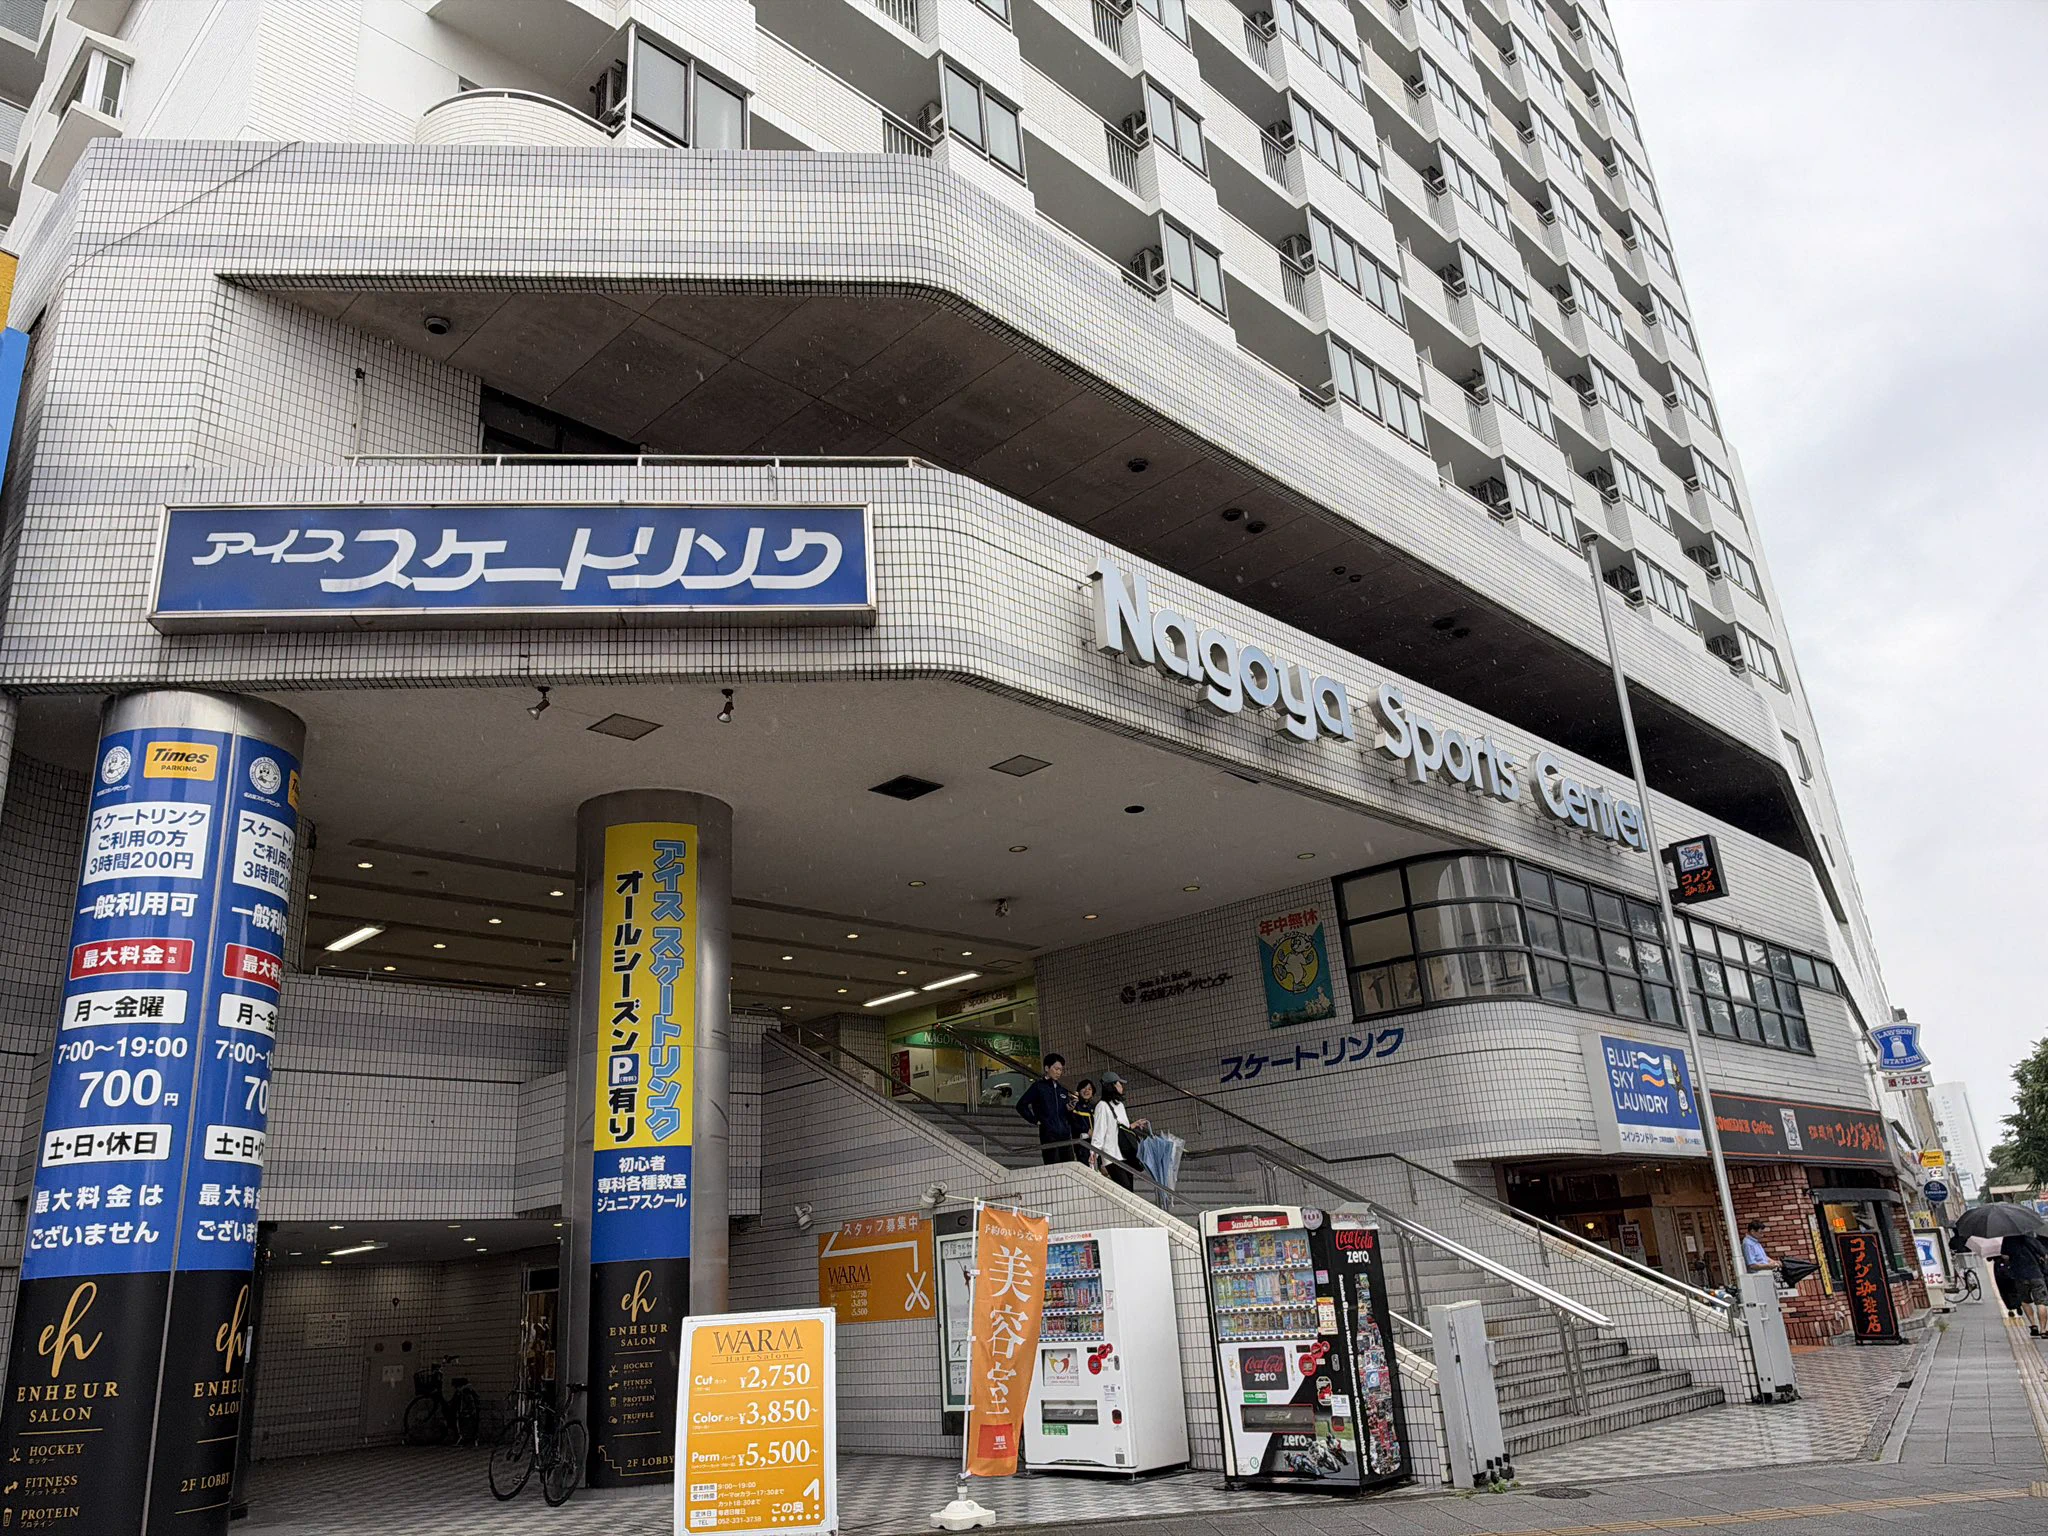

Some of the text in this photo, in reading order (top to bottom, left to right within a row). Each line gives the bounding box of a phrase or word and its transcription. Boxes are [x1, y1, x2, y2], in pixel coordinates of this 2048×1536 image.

[1086, 556, 1354, 743] Nagoya
[1368, 681, 1520, 803] Sports
[153, 748, 209, 764] Times
[161, 765, 198, 773] PARKING
[92, 808, 206, 833] スケートリンク
[98, 830, 189, 851] ご利用の方
[90, 851, 194, 875] 3時間200円
[79, 891, 198, 920] 一般利用可
[1259, 908, 1318, 936] 年中無休
[82, 945, 165, 969] 最大料金
[645, 839, 686, 1142] アイス スケートリンク
[1877, 1028, 1912, 1039] LAWSON
[1220, 1027, 1404, 1084] スケートリンク
[1606, 1047, 1639, 1069] BLUE
[1883, 1054, 1920, 1065] STATION
[1611, 1069, 1634, 1090] SKY
[1615, 1091, 1669, 1114] LAUNDRY
[1751, 1119, 1775, 1136] Coffee
[1621, 1131, 1658, 1144] コインランドリー
[618, 1155, 666, 1173] 初心者
[597, 1174, 687, 1193] 専科各種教室
[34, 1184, 164, 1214] 最大料金は
[597, 1192, 687, 1213] ジュニアスクール
[844, 1215, 918, 1236] スタッフ募集中
[1252, 1216, 1259, 1227] 8
[1259, 1218, 1277, 1227] hours
[31, 1221, 159, 1249] ございません
[984, 1224, 1043, 1241] 予約のいらない
[1346, 1250, 1370, 1264] zero
[828, 1263, 871, 1285] WARM
[610, 1323, 668, 1336] ENHEUR
[986, 1245, 1034, 1416] 美容室
[620, 1336, 656, 1347] SALON
[713, 1326, 803, 1354] WARM
[623, 1362, 654, 1370] HOCKEY
[623, 1378, 653, 1387] FITNESS
[694, 1374, 713, 1386] Cut
[740, 1362, 811, 1390] ¥2,750
[1254, 1372, 1277, 1382] zero
[17, 1380, 120, 1402] ENHEUR
[622, 1395, 656, 1403] PROTEIN
[29, 1406, 93, 1423] SALON
[623, 1411, 655, 1420] TRUFFLE
[693, 1411, 724, 1424] Color
[1282, 1434, 1306, 1447] zero
[29, 1443, 85, 1457] HOCKEY
[691, 1452, 720, 1463] Perm
[626, 1455, 674, 1468] 2F LOBBY
[25, 1475, 78, 1488] FITNESS
[180, 1471, 231, 1493] 2F LOBBY
[21, 1506, 80, 1520] PROTEIN
[771, 1502, 804, 1514] この奥
